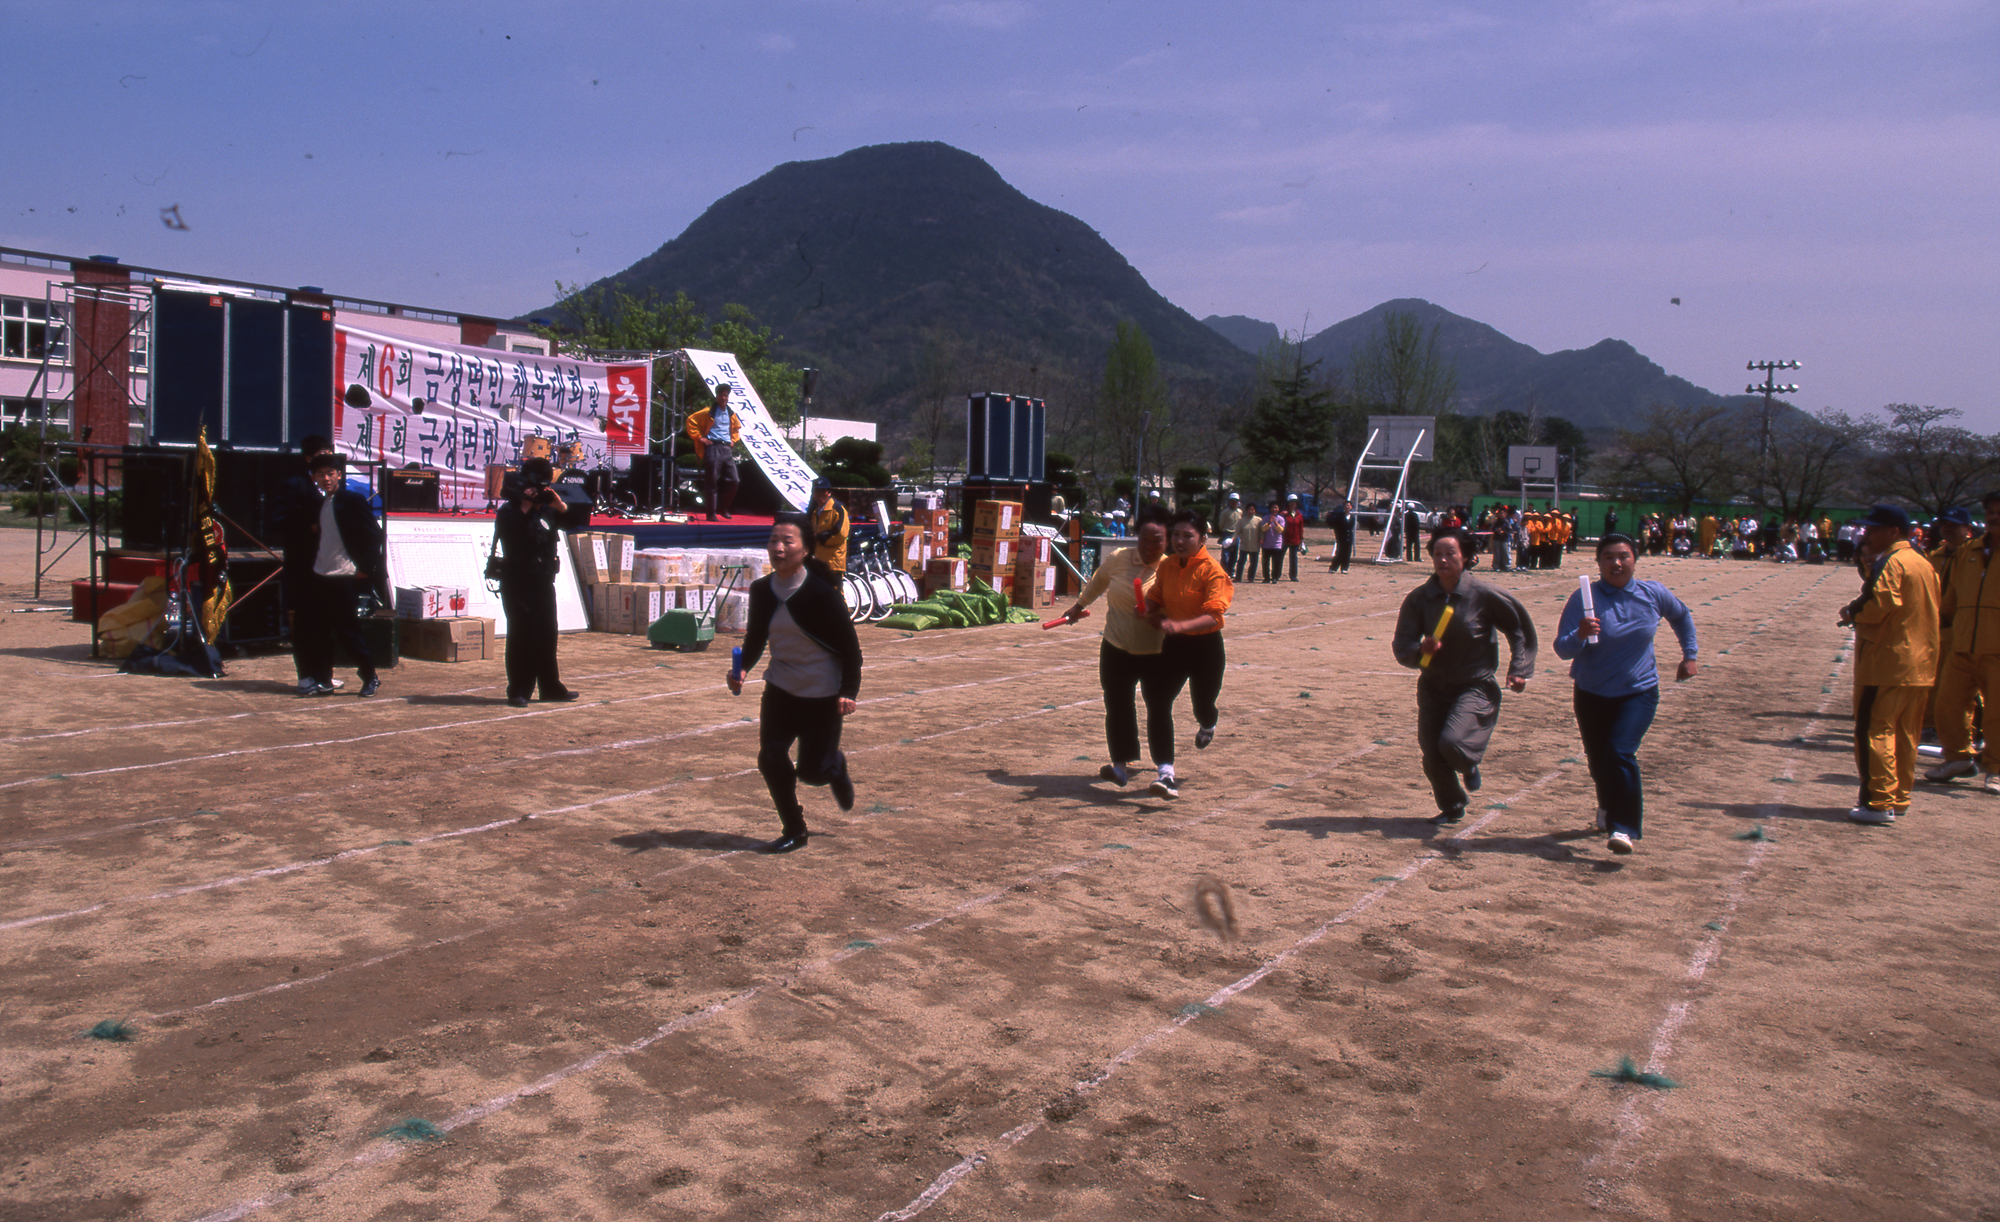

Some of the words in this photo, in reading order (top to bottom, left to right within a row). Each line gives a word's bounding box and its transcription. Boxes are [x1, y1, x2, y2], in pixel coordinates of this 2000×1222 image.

[357, 343, 413, 399] 제6회
[424, 351, 503, 409] 금성면민
[510, 359, 584, 417] 체육대회
[588, 381, 600, 417] 및
[612, 376, 641, 441] 축
[716, 362, 757, 415] 만들자
[355, 412, 407, 466] 제1회
[418, 415, 498, 471] 금성면민
[462, 482, 477, 500] 17
